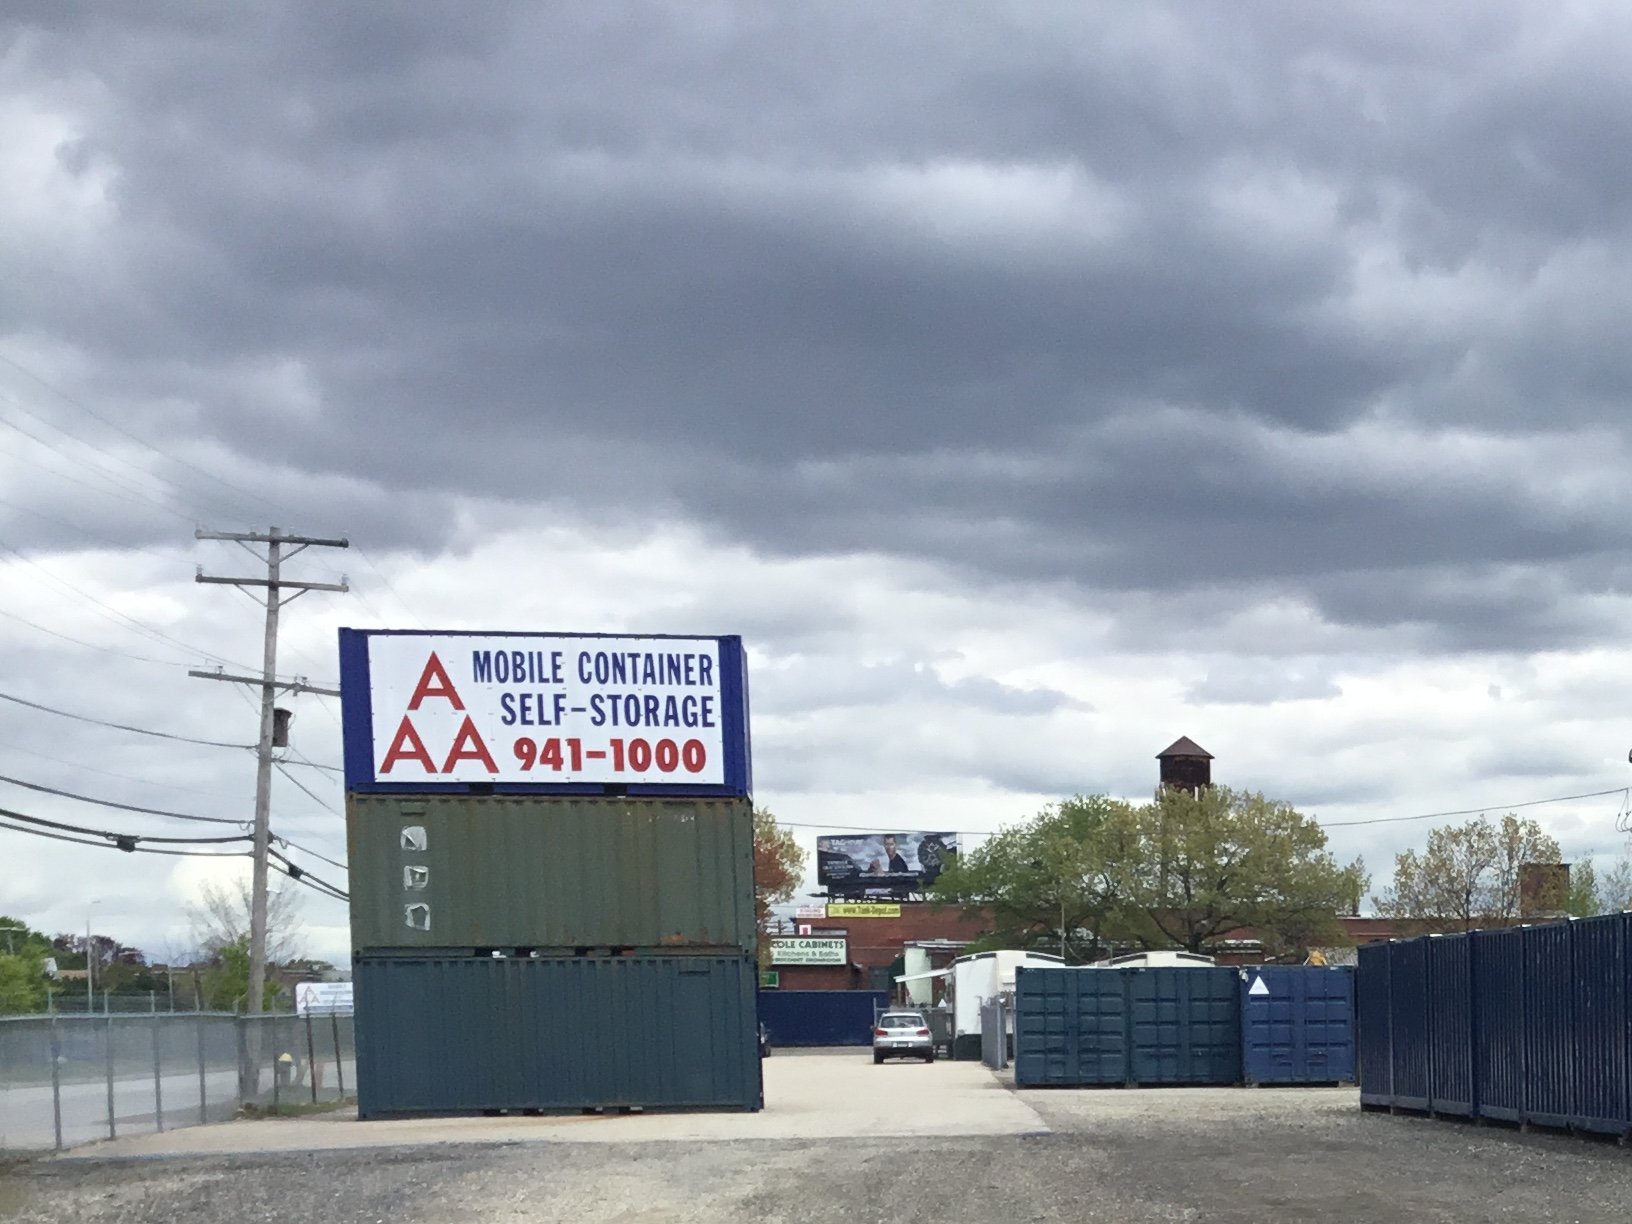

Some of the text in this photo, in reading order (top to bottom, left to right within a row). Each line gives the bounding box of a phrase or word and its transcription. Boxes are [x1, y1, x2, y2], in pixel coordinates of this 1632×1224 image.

[472, 650, 713, 686] MOBILE CONTAINER
[500, 693, 716, 728] SELF-STORAGE
[513, 737, 706, 773] 941-1000
[798, 940, 844, 949] CABINETS
